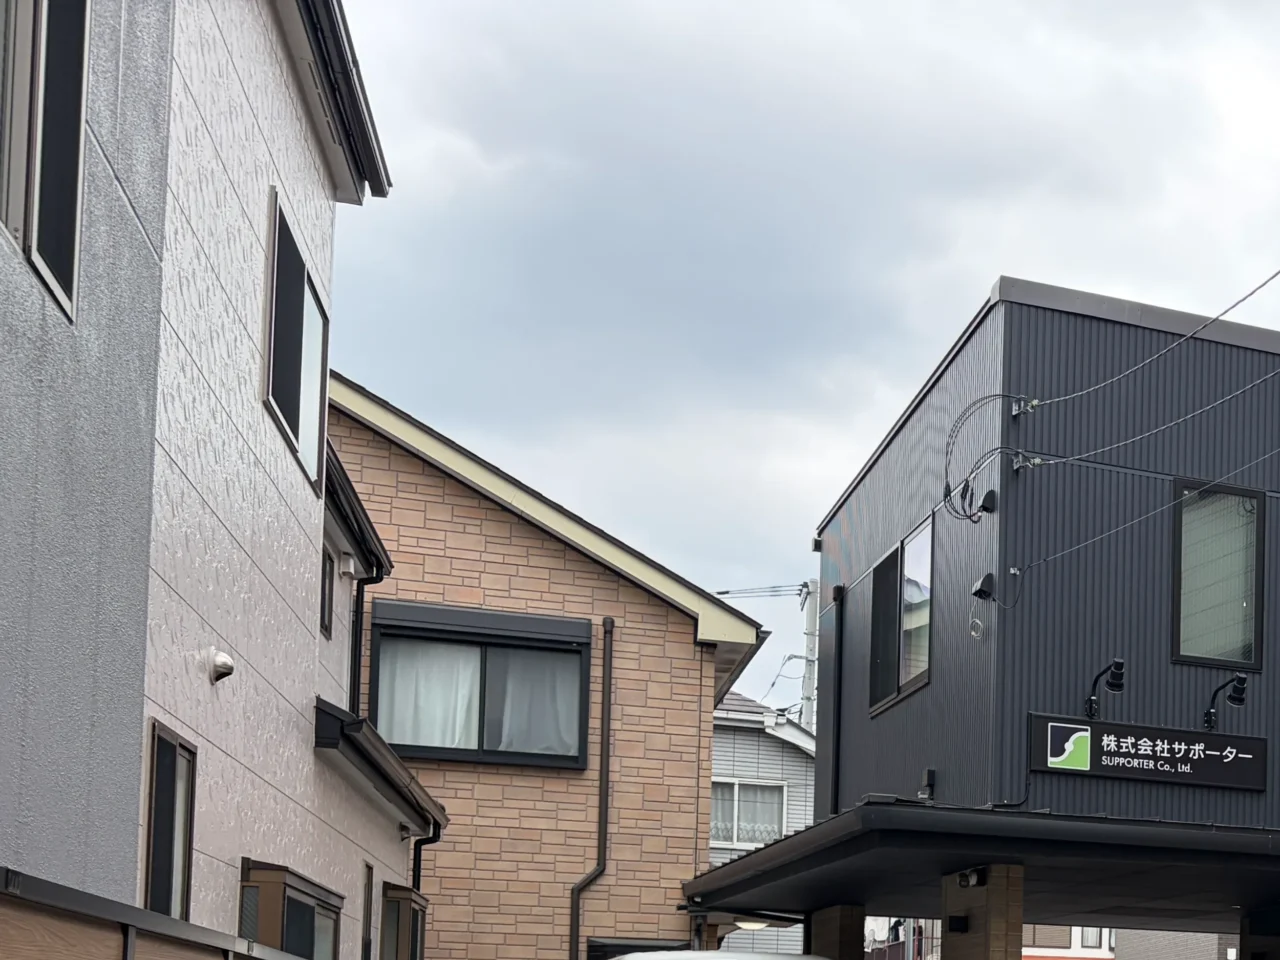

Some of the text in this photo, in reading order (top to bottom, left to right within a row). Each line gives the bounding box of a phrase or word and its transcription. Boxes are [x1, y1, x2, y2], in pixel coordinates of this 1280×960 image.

[1101, 733, 1253, 763] 株式会社サポーター
[1101, 755, 1193, 773] SUPPORTER Co., Ltd.
